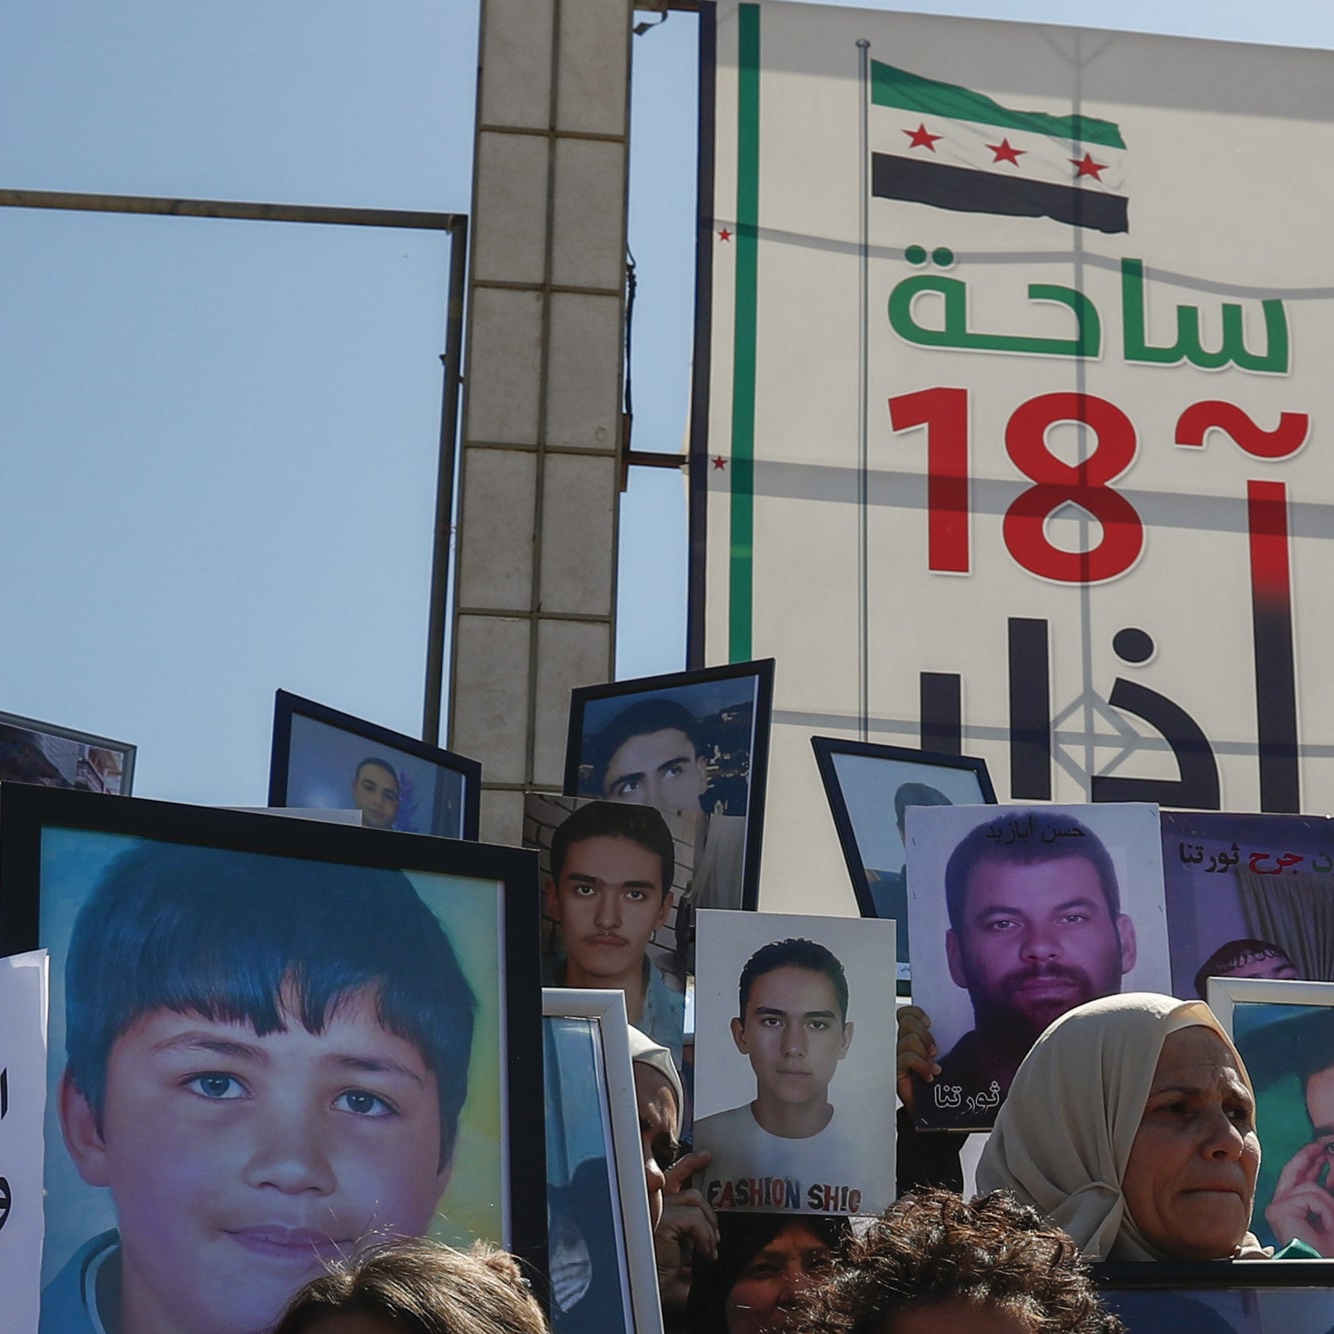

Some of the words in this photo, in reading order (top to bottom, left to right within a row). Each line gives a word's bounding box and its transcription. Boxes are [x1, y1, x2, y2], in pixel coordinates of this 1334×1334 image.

[887, 244, 1291, 375] ساحة
[887, 386, 1145, 584] 18
[1041, 824, 1085, 844] حسن
[1179, 842, 1240, 873] ثورتنا
[1248, 851, 1305, 875] جرح
[933, 1080, 1001, 1115] ثورتنا
[707, 1177, 801, 1210] FASHION
